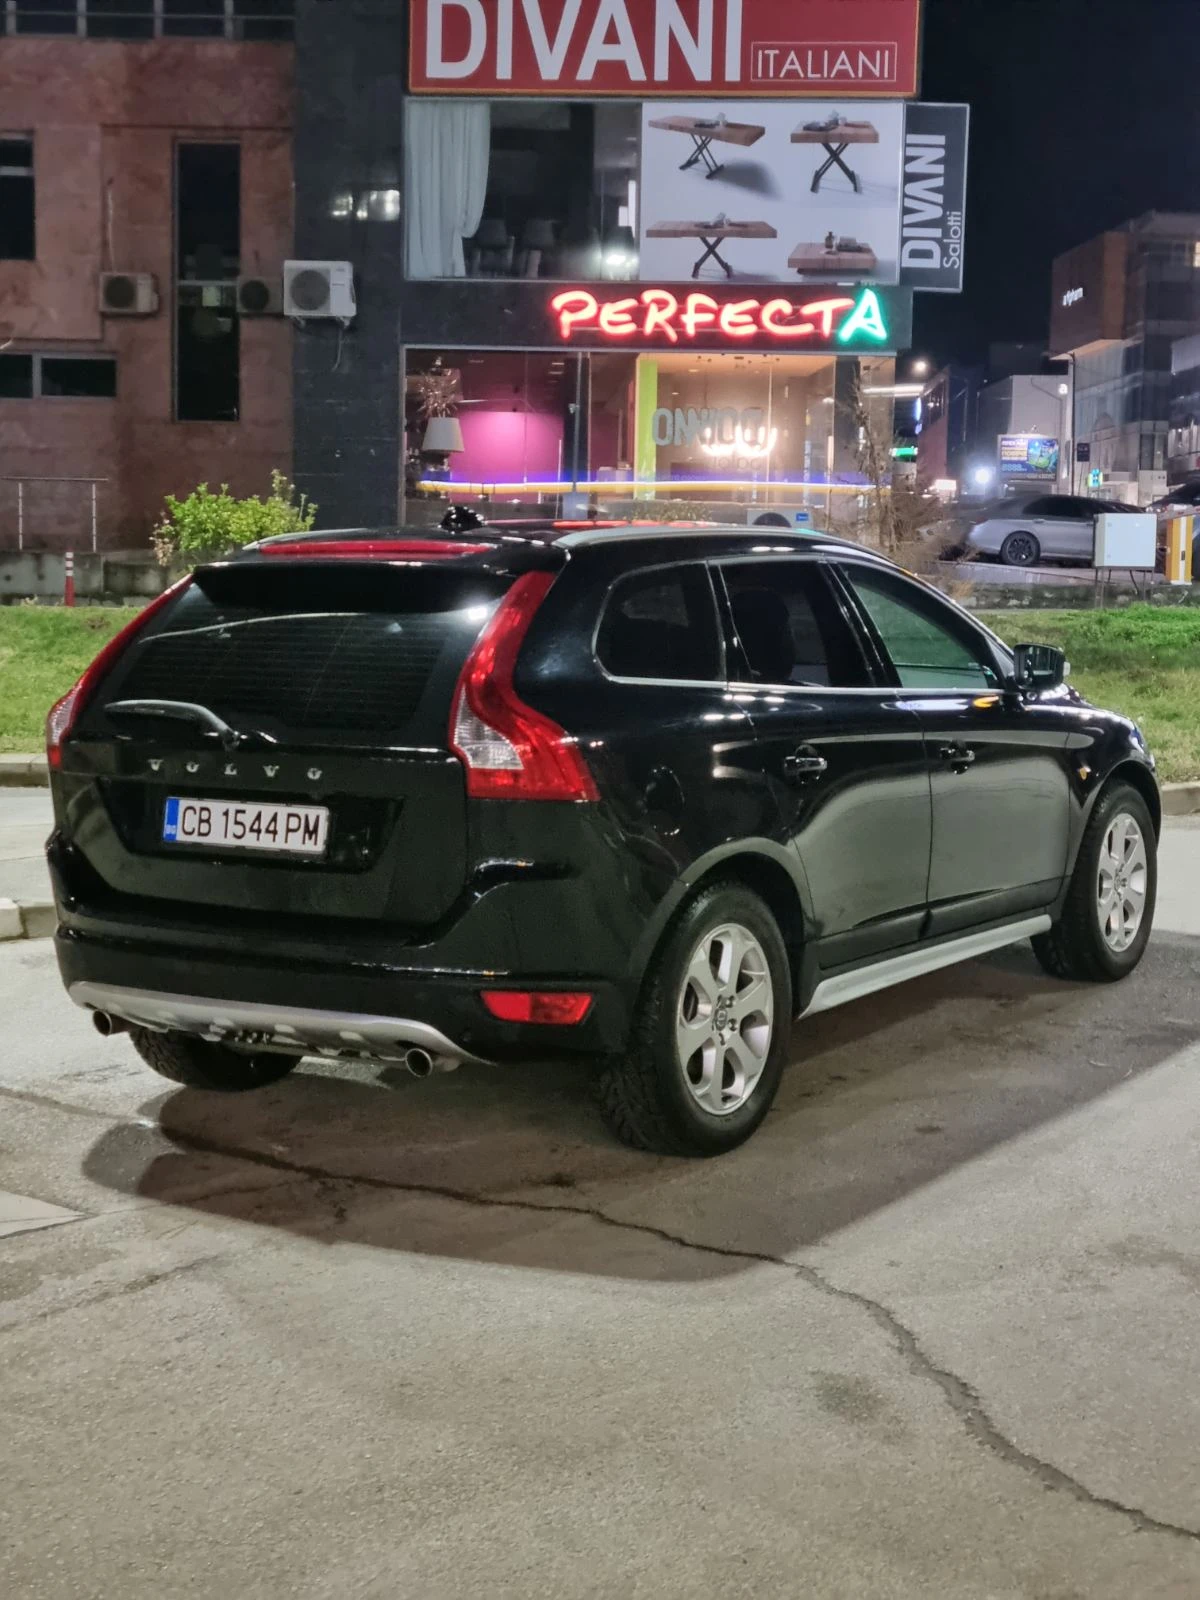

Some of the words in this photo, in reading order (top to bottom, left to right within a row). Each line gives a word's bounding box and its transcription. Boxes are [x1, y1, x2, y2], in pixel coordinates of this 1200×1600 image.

[426, 0, 742, 81] DIVANI
[758, 50, 889, 78] ITALIANI
[901, 133, 945, 268] DIVANI
[943, 211, 962, 269] Salotti
[552, 288, 887, 343] PERFECTA
[148, 759, 323, 780] VOLVO
[181, 806, 212, 837] CB
[222, 808, 278, 843] 1544
[284, 813, 320, 846] PM
